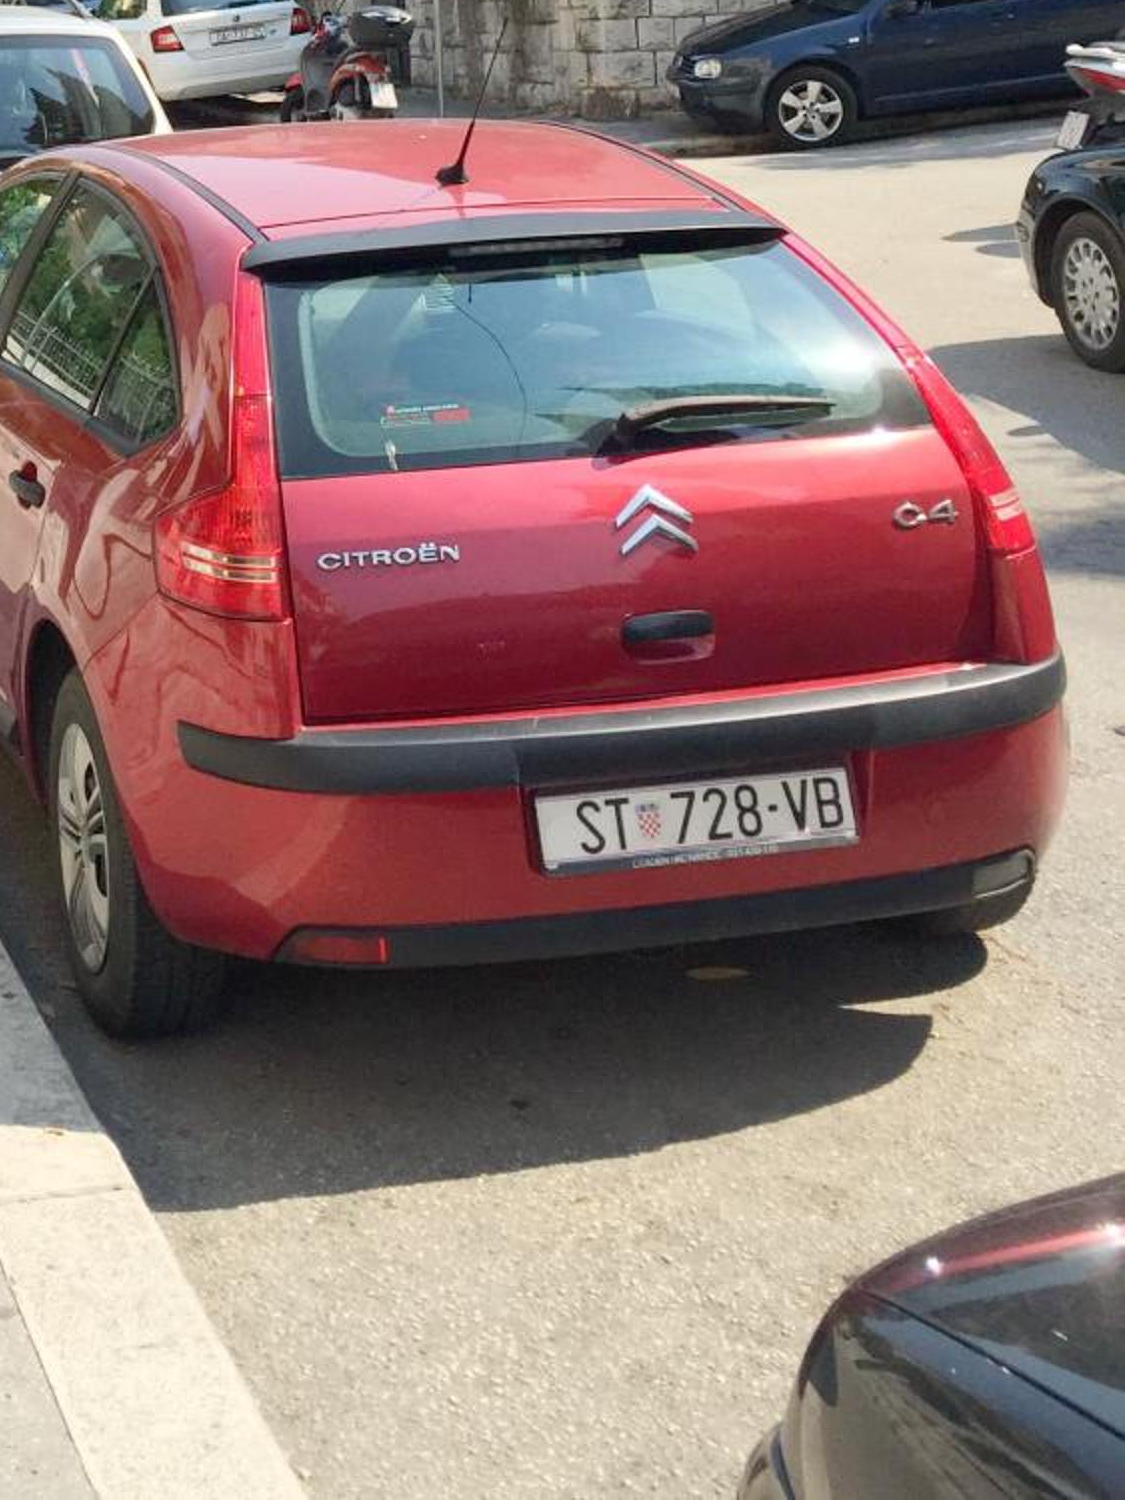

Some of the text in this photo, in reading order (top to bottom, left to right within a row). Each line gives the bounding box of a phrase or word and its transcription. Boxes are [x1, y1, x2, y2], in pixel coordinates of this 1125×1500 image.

[892, 499, 959, 528] C4
[317, 541, 460, 571] CITROËN
[576, 777, 845, 854] ST 728-VB
